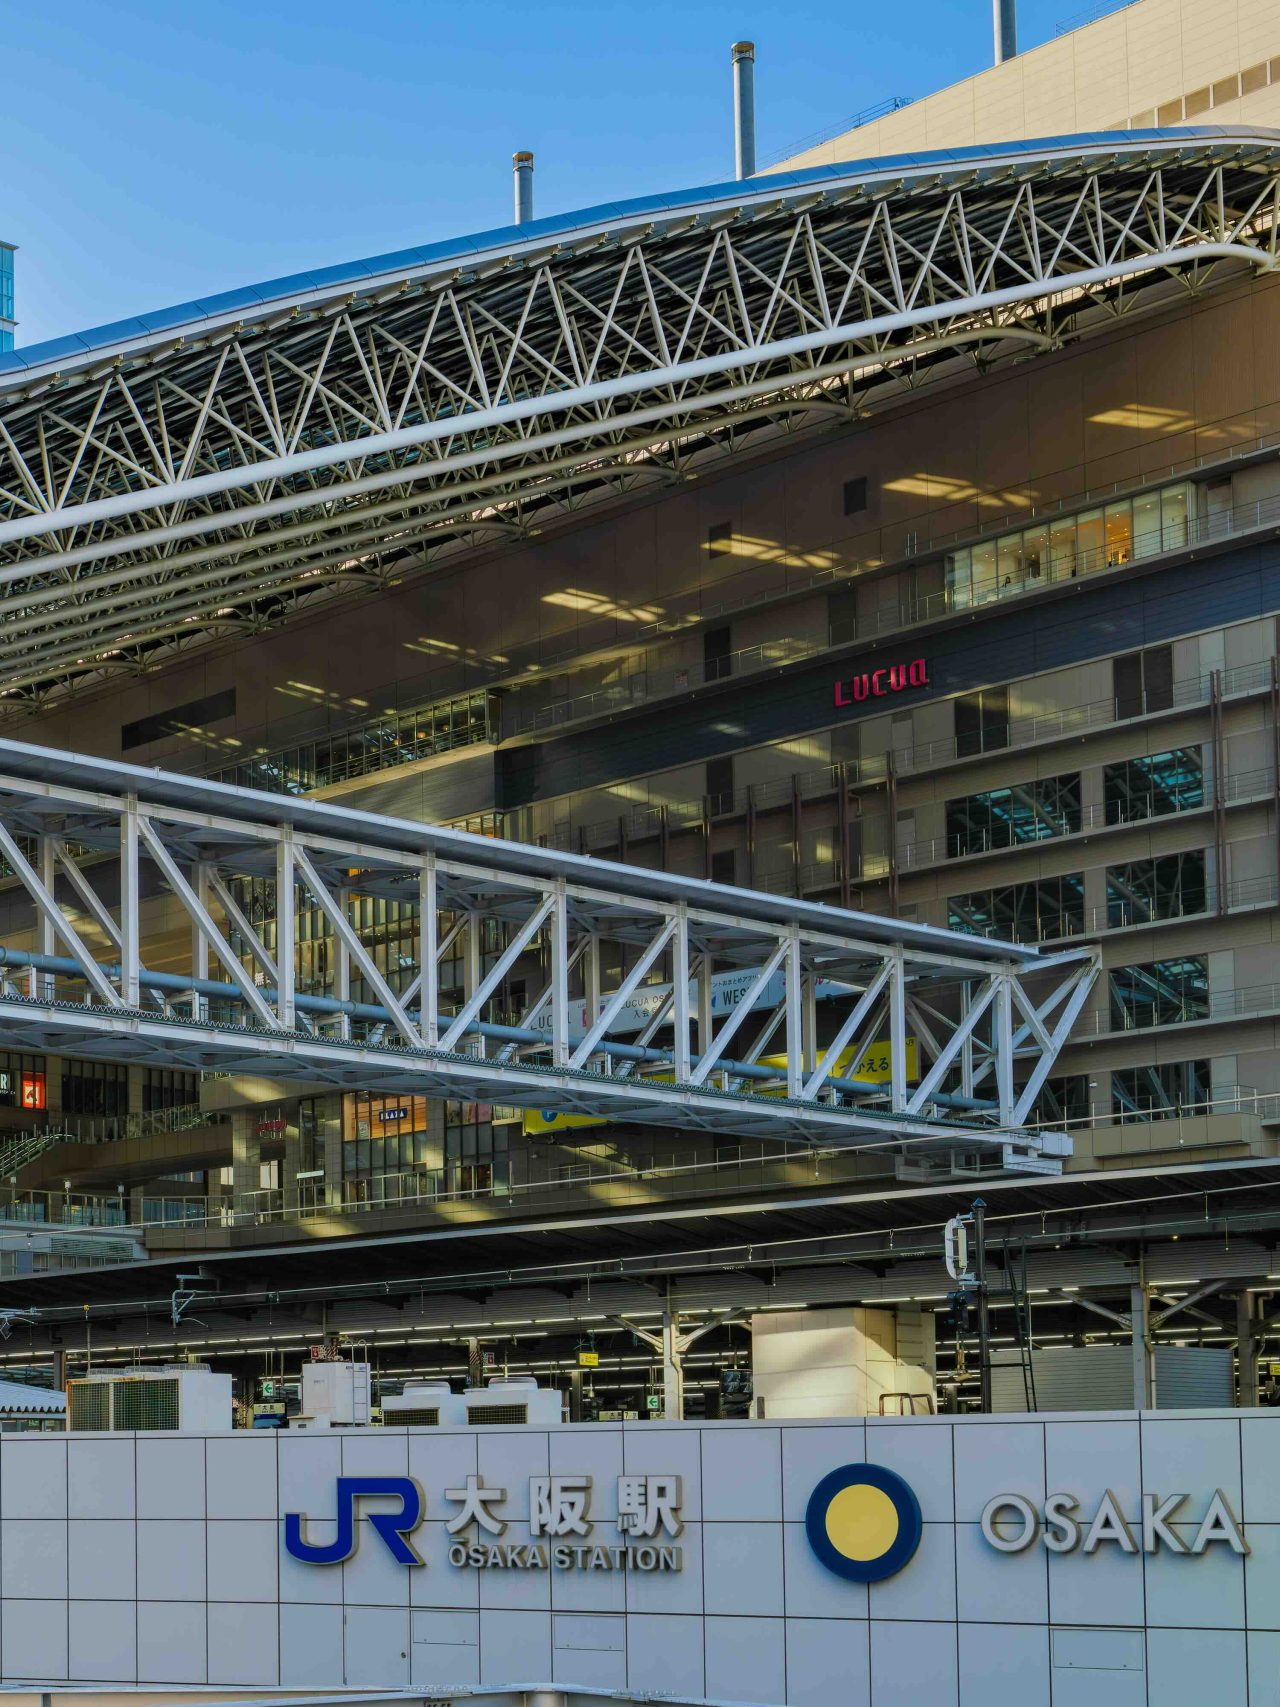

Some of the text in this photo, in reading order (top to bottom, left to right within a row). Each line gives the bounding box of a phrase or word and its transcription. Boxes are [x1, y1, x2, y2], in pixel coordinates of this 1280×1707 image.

[285, 1474, 683, 1566] JR 大阪駅
[980, 1488, 1251, 1555] OSAKA
[553, 1544, 682, 1571] STATION
